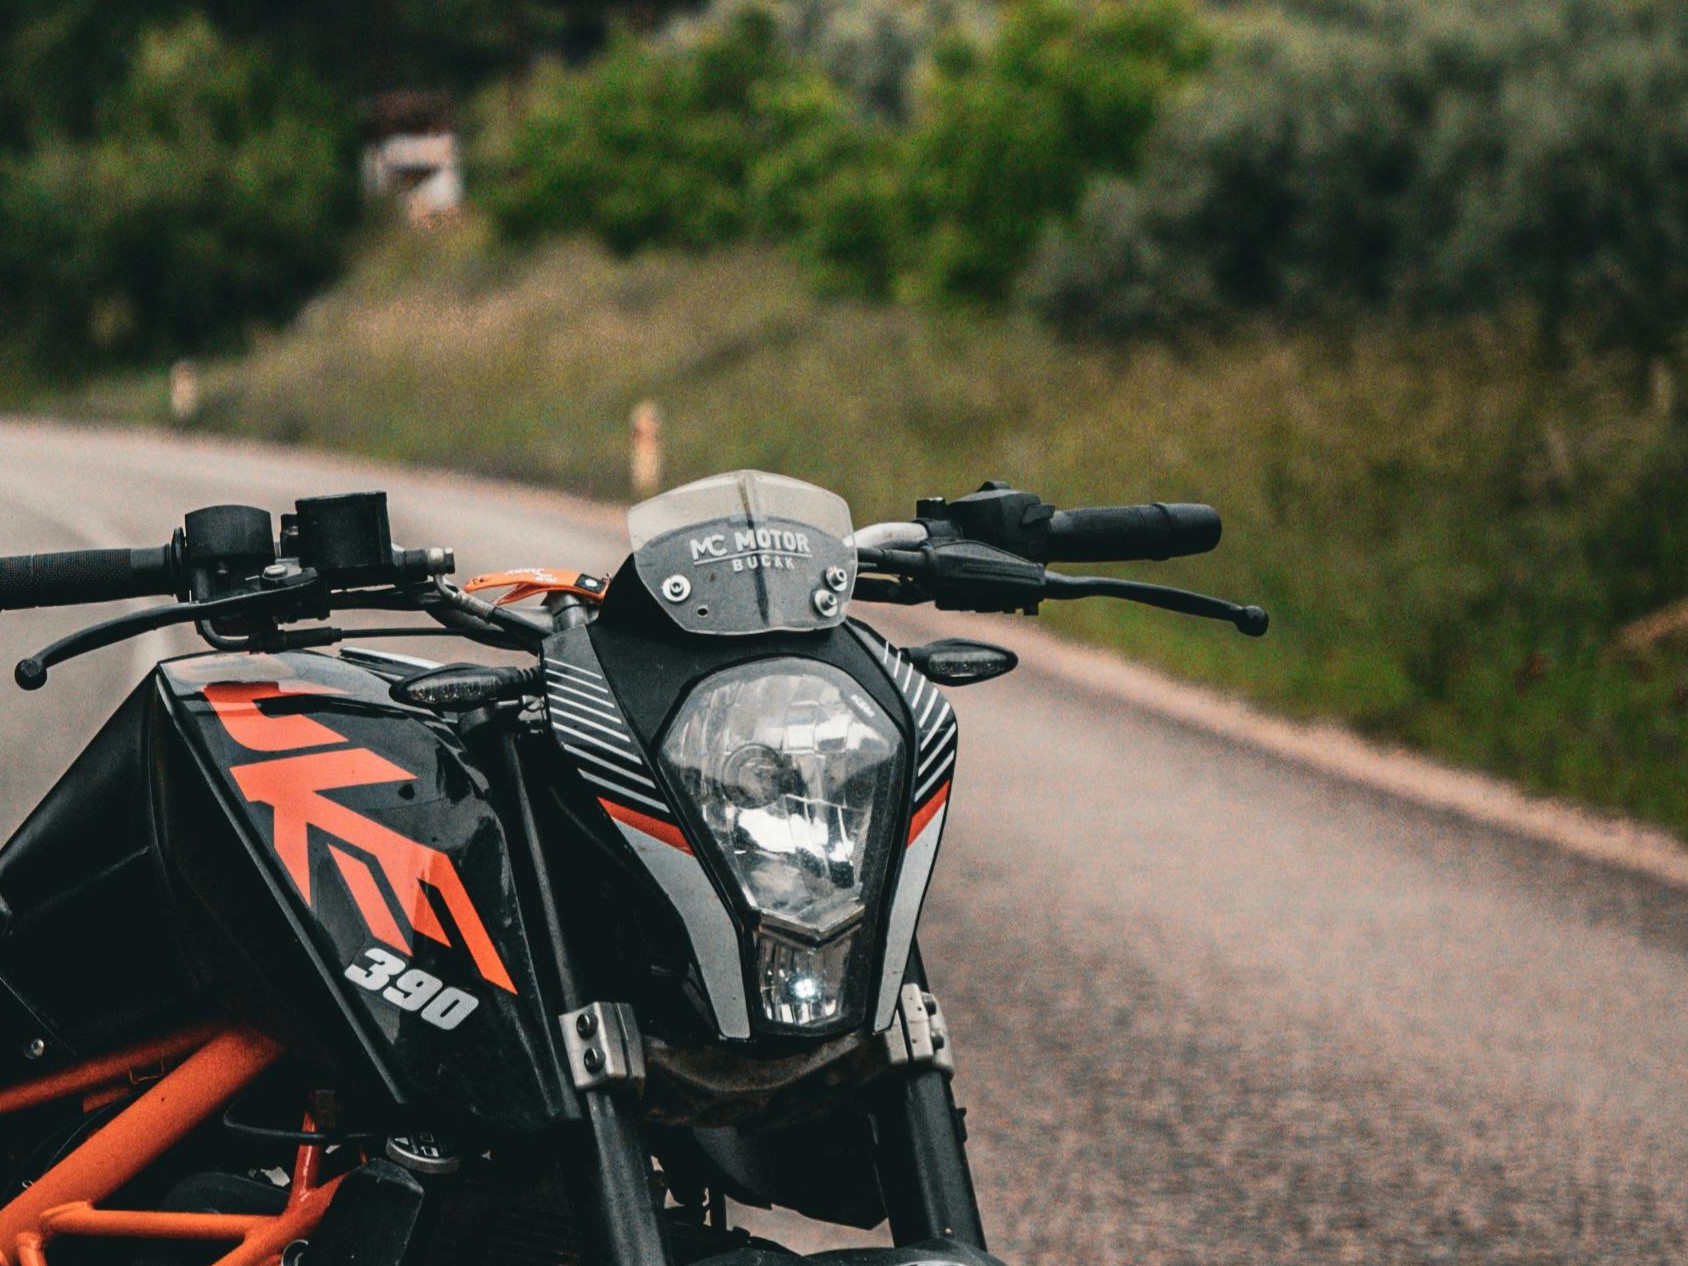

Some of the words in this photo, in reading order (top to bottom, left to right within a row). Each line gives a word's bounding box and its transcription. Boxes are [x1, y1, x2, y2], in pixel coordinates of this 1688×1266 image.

[690, 533, 728, 560] MC
[734, 528, 810, 553] MOTOR
[732, 554, 795, 572] BUCAK
[344, 947, 480, 1031] 390
